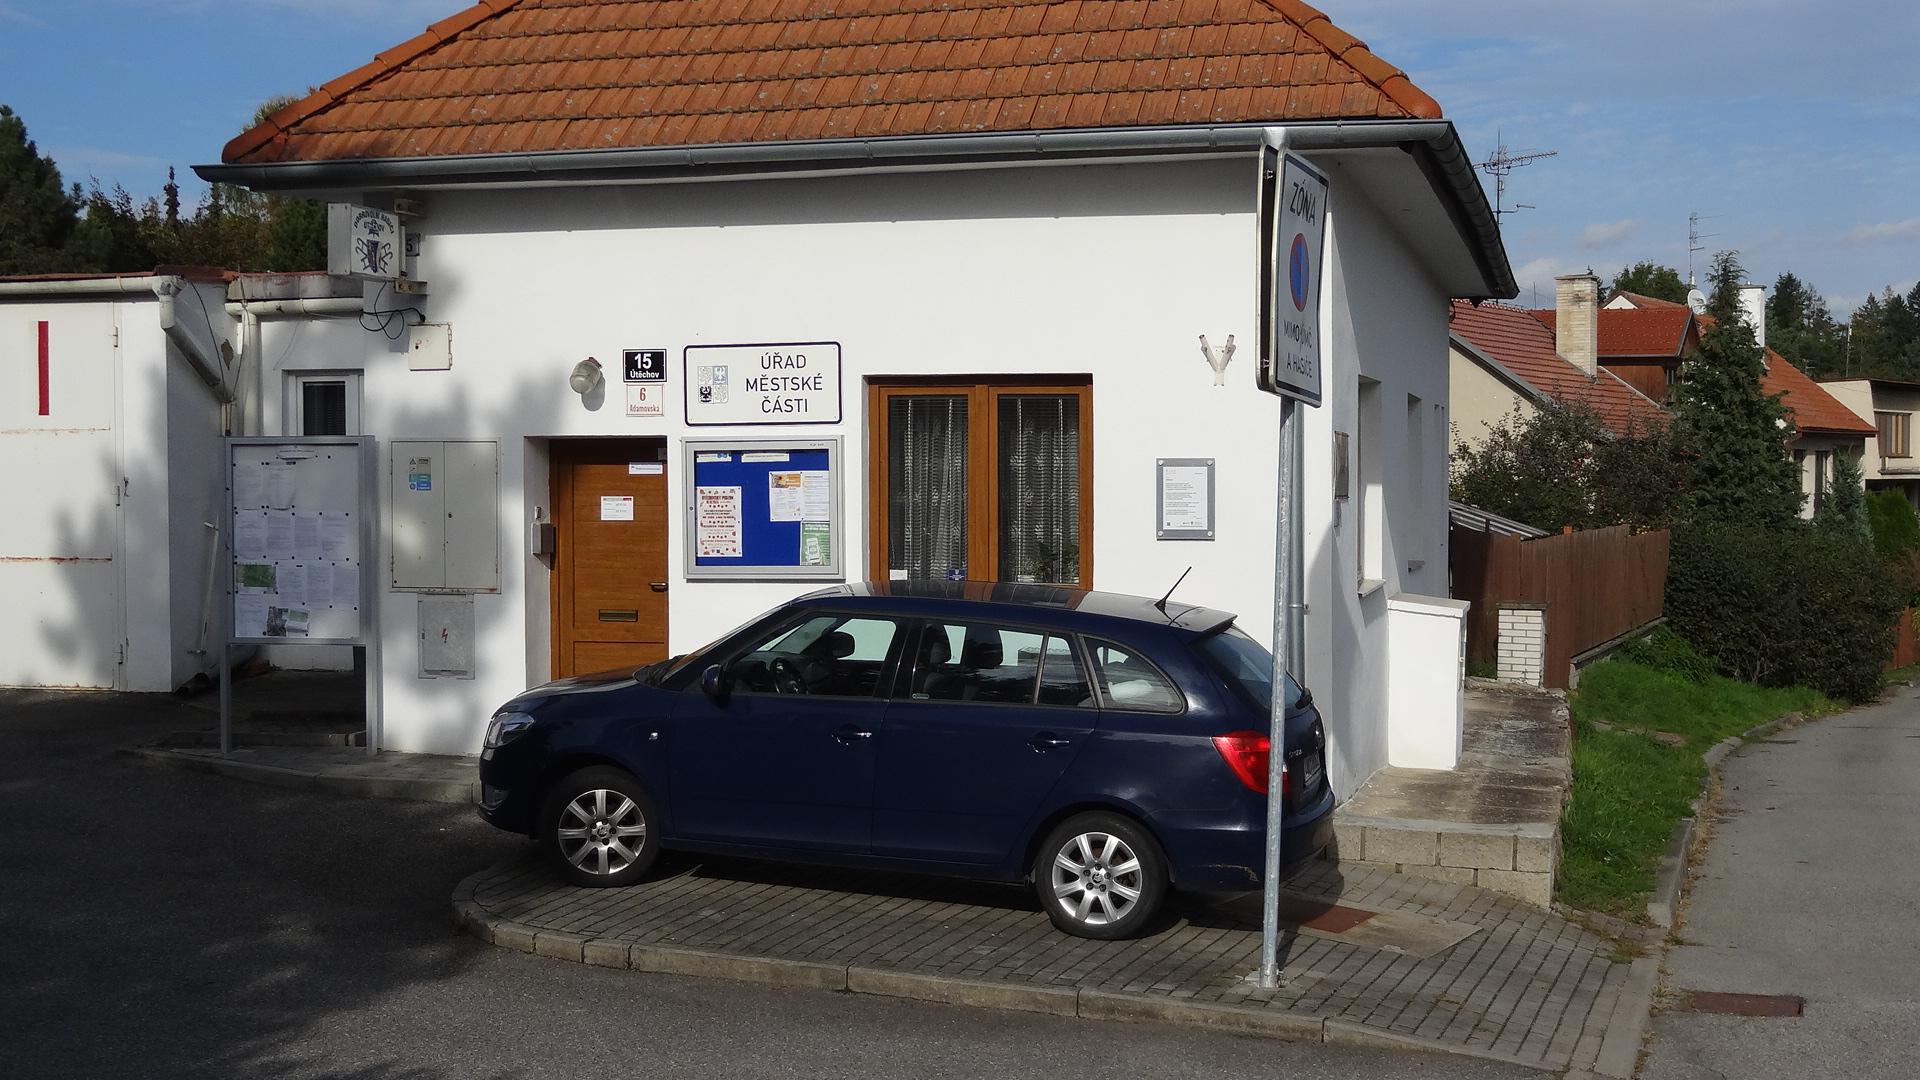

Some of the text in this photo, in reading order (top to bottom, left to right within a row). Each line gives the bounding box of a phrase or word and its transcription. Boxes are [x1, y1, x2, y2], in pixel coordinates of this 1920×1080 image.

[1290, 179, 1316, 226] ZÓNA
[1284, 320, 1300, 343] MIMO
[634, 352, 652, 370] 15
[761, 352, 807, 370] ÚŘAD
[1287, 352, 1292, 370] A
[629, 369, 660, 379] Útěchov
[745, 373, 823, 392] MĚSTSKÉ
[639, 387, 647, 402] 6
[761, 395, 808, 413] ČÁSTI
